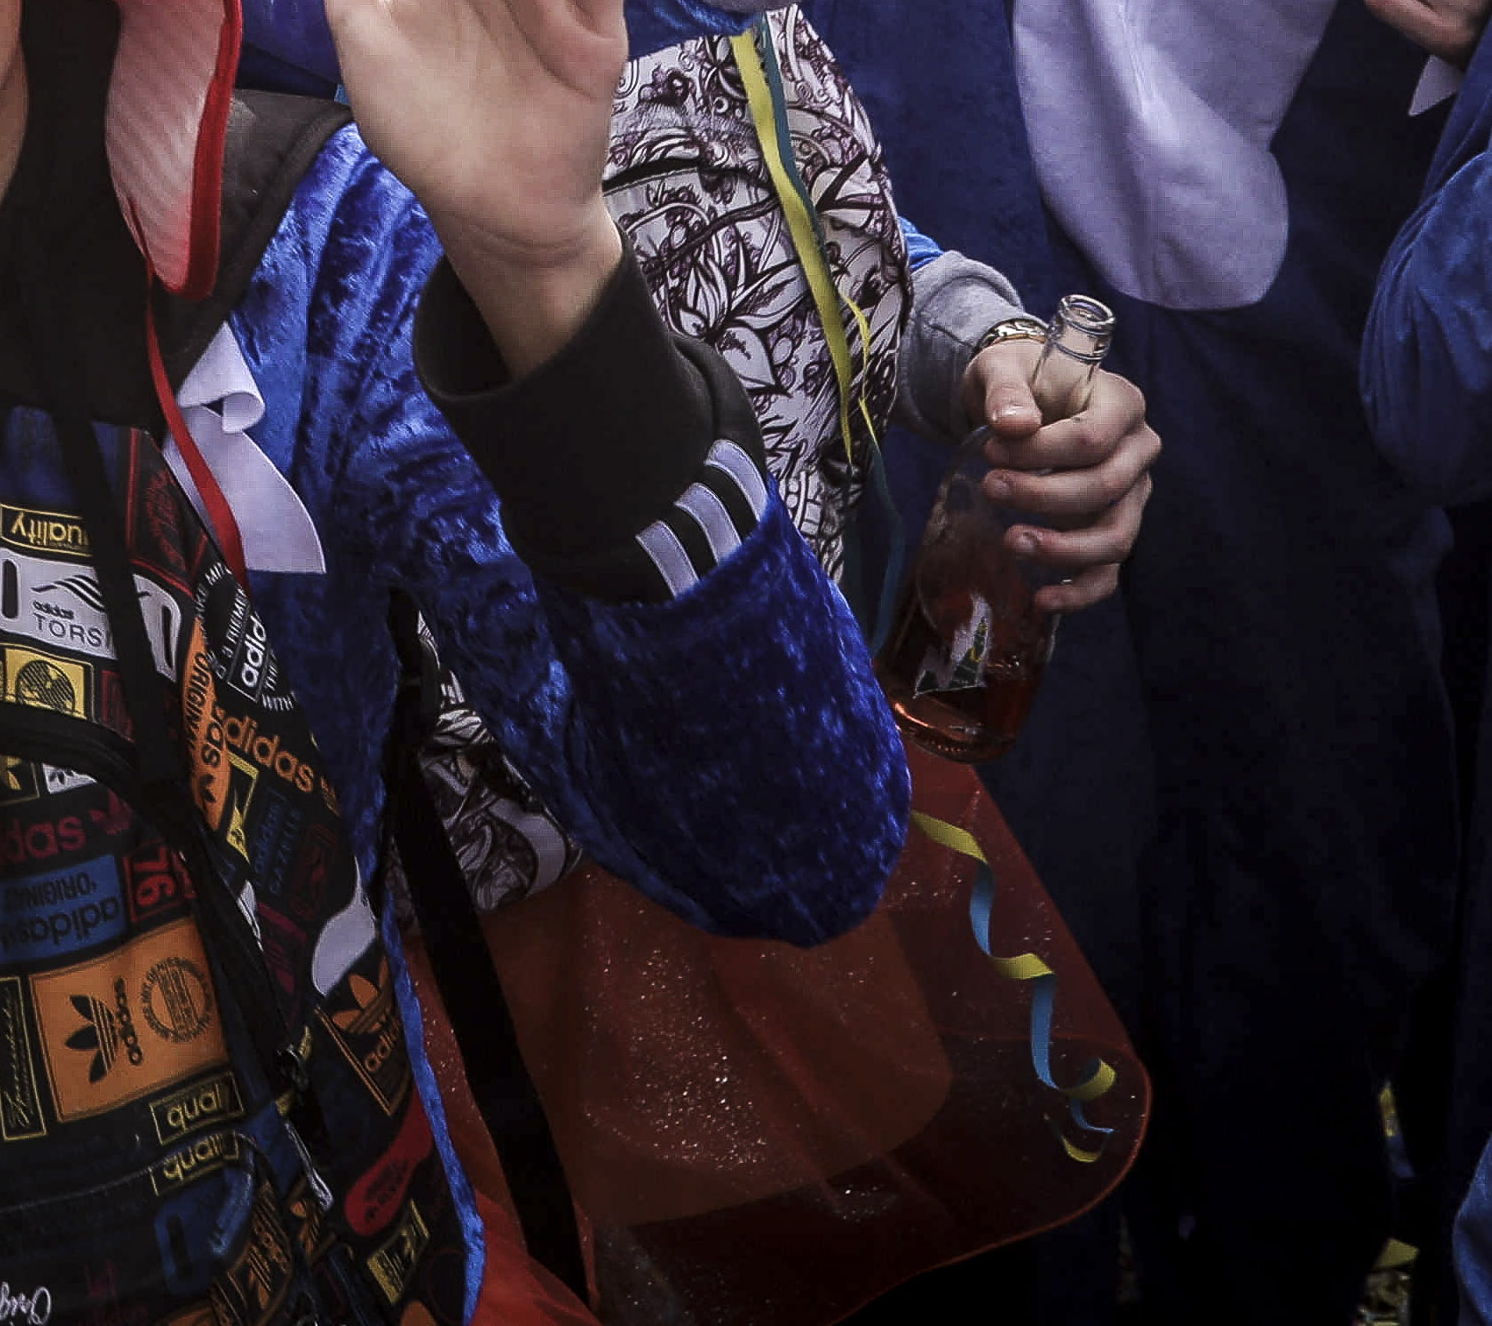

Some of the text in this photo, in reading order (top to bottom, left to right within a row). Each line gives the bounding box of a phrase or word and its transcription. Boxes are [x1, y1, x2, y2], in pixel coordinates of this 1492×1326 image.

[32, 600, 75, 620] adidas
[16, 896, 119, 946] adidas
[113, 974, 143, 1066] adidas
